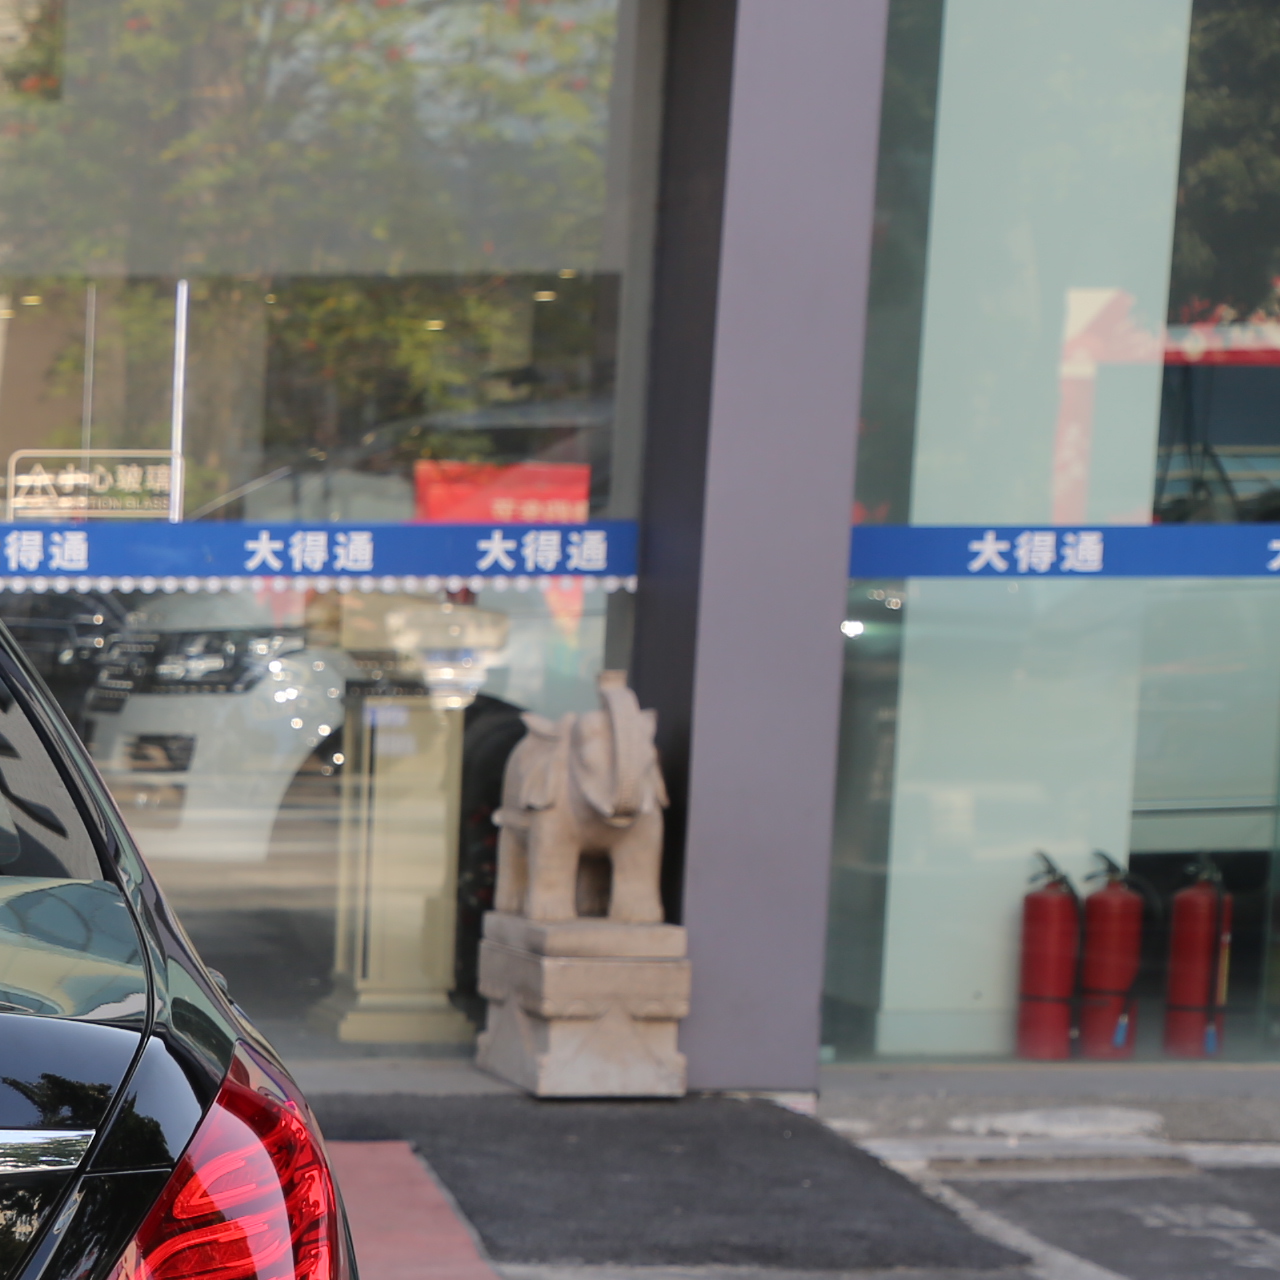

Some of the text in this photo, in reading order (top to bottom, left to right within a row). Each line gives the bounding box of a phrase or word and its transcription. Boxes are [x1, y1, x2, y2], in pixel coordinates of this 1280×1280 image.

[244, 529, 374, 572] 大得通
[476, 529, 608, 572] 大得通
[967, 530, 1104, 573] 大得通
